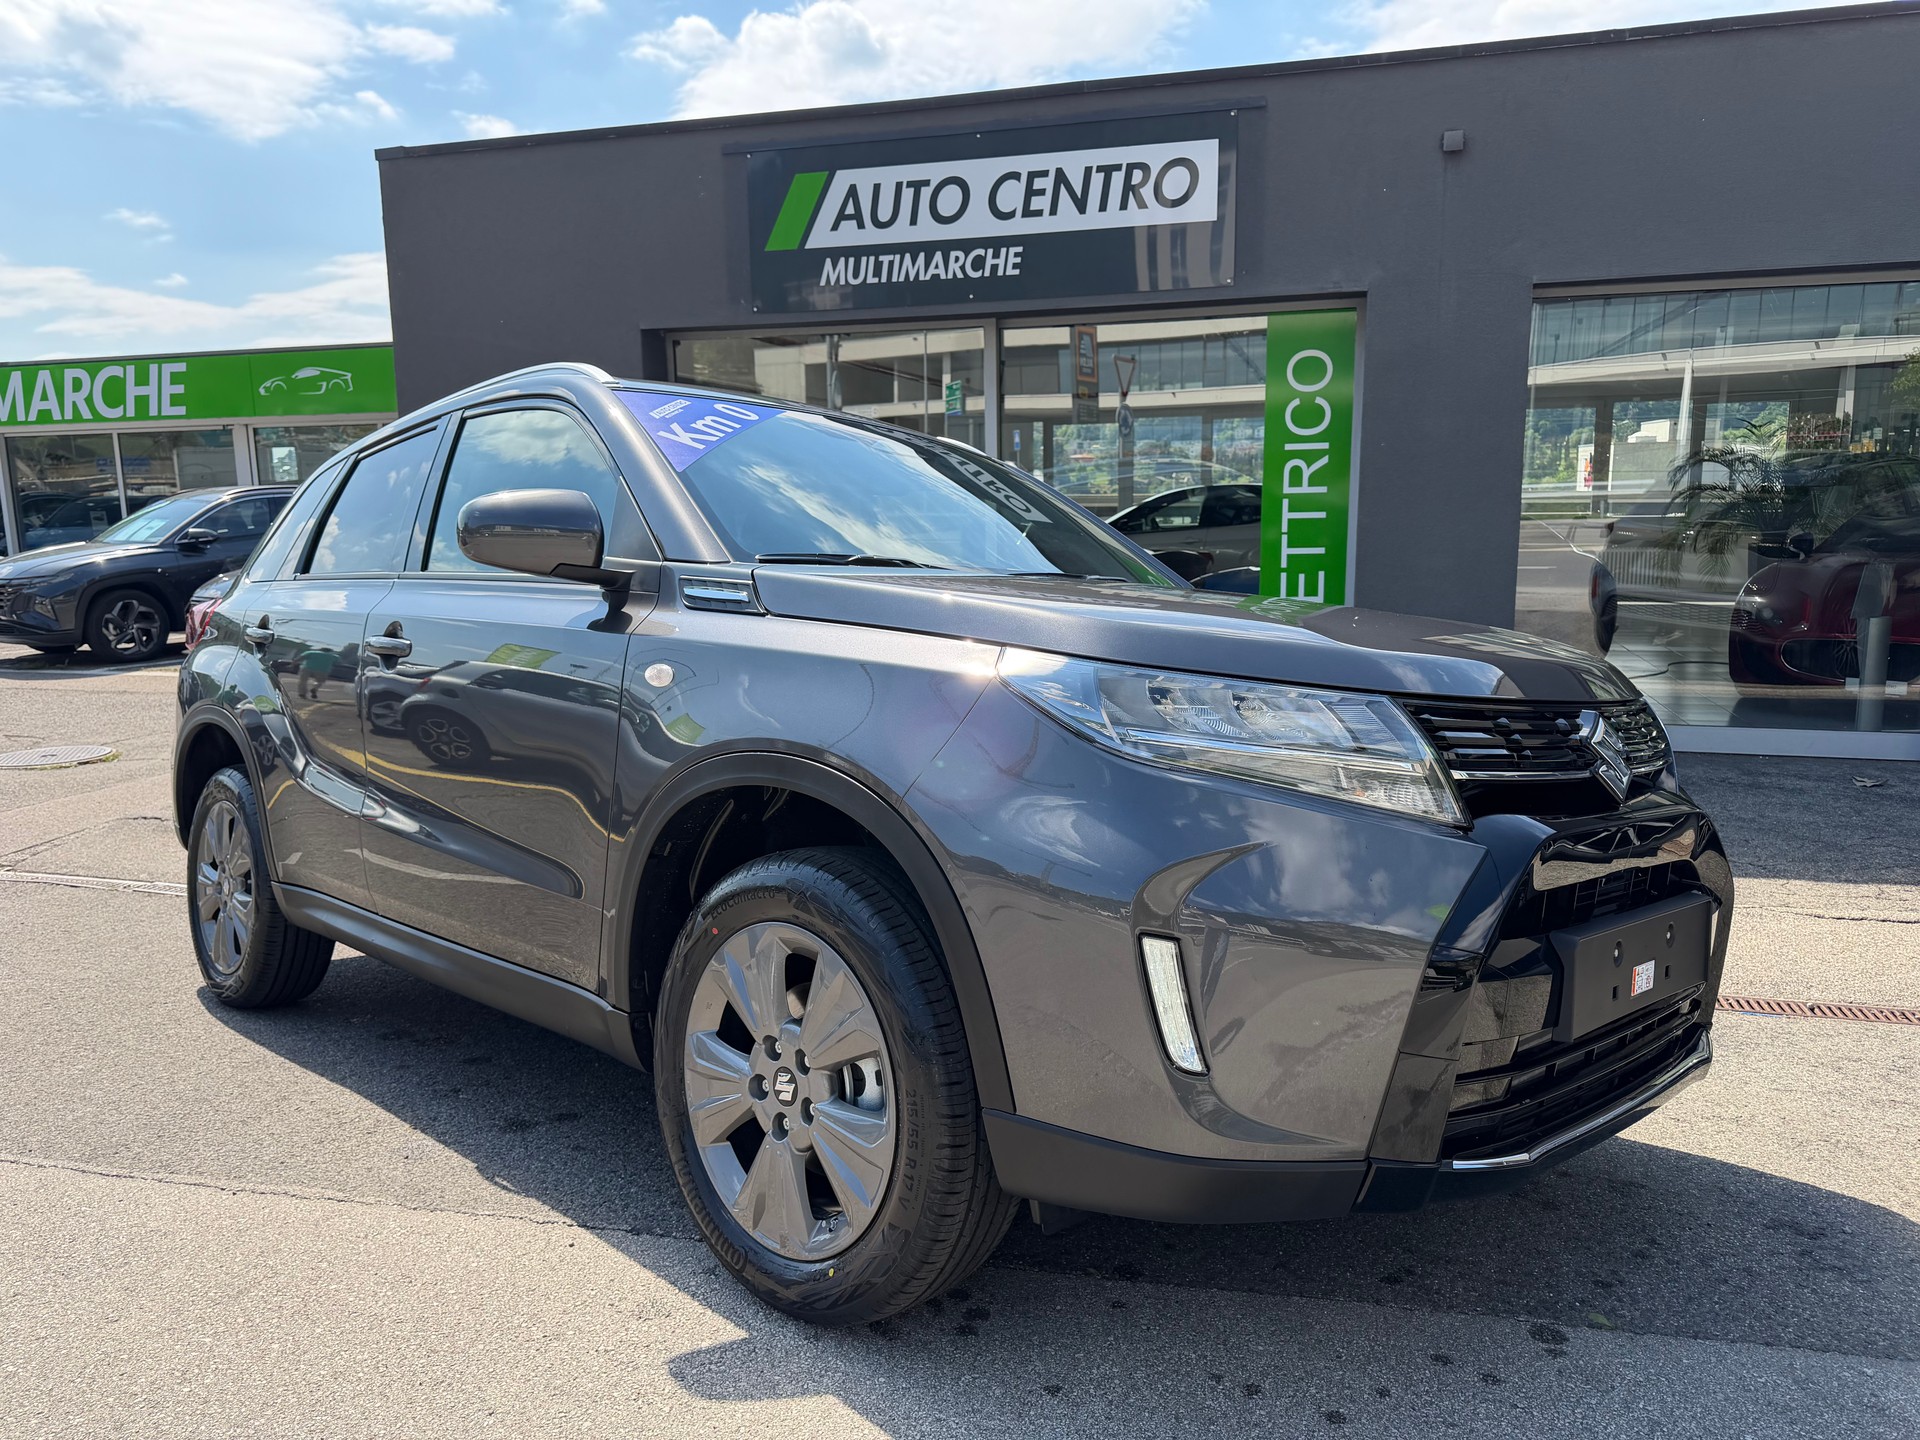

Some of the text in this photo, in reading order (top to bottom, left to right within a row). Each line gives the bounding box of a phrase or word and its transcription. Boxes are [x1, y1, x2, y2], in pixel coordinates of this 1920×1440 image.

[829, 156, 1200, 232] AUTO CENTRO
[818, 245, 1023, 287] MULTIMARCHE
[656, 403, 760, 450] Km 0
[905, 1089, 919, 1151] 215/55
[902, 1172, 915, 1194] 17
[904, 1156, 917, 1170] R
[898, 1196, 910, 1212] V
